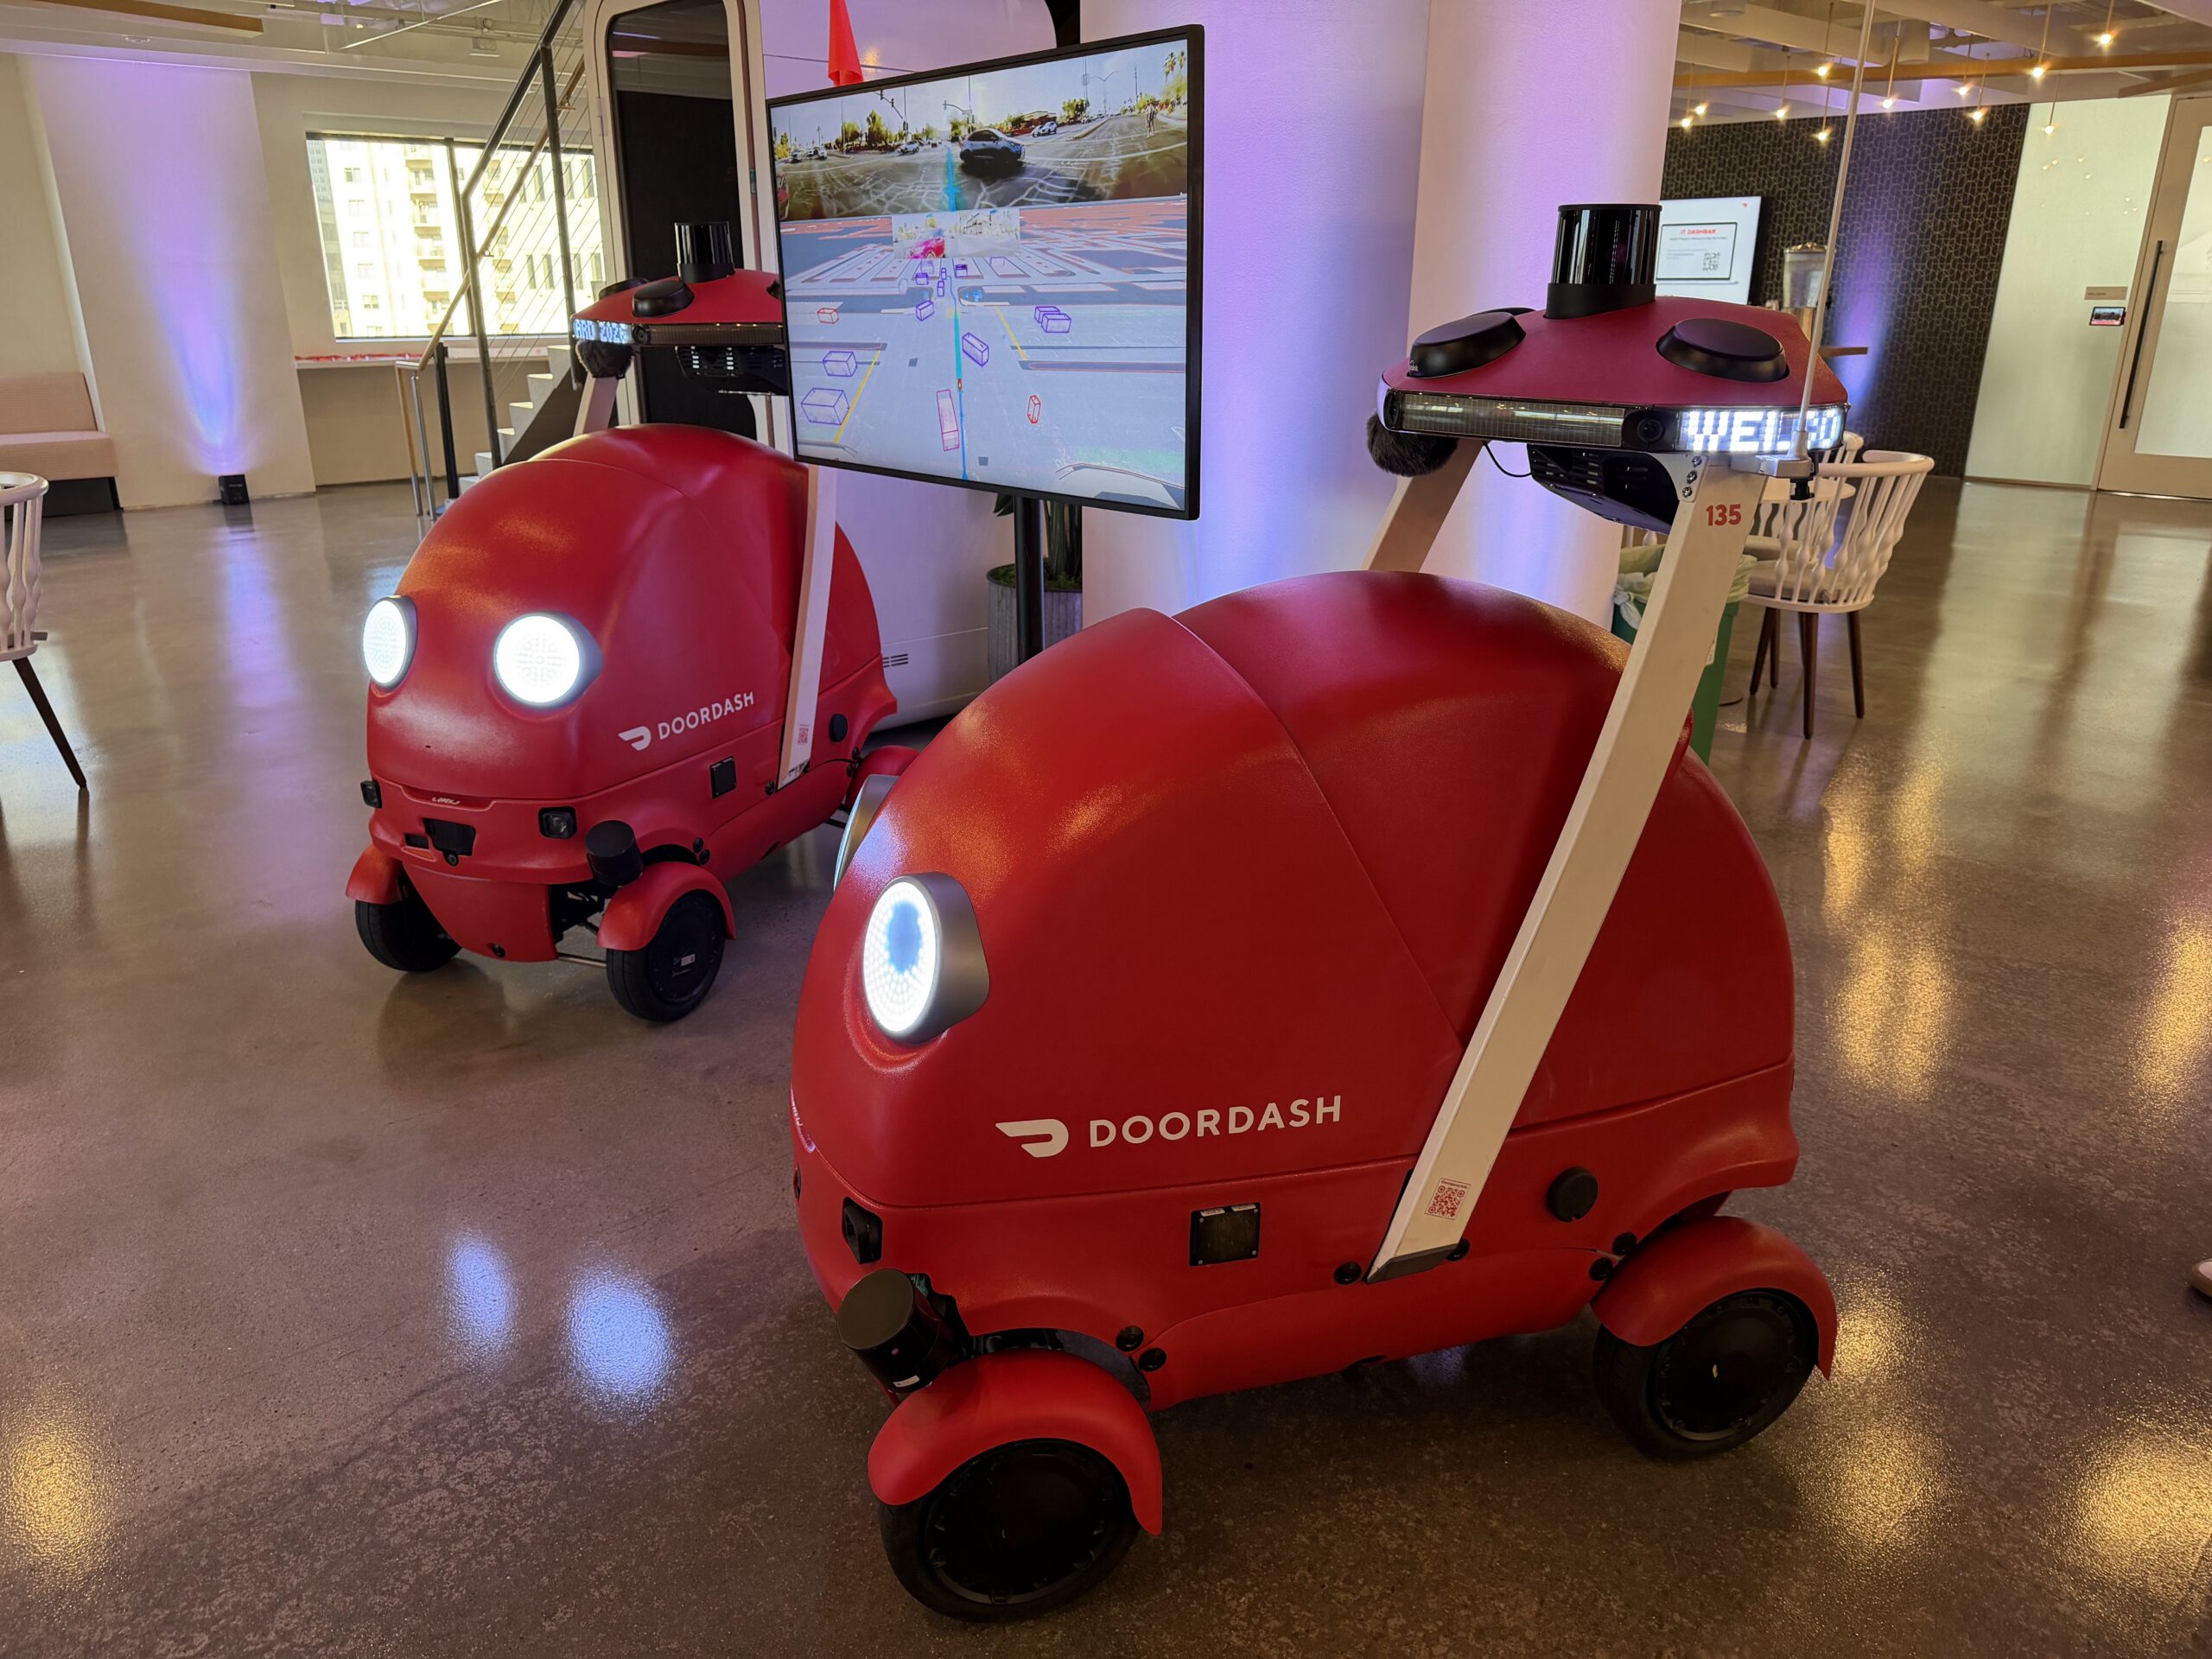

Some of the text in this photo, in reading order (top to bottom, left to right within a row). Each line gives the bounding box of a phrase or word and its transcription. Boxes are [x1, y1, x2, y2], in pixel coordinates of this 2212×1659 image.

[1706, 504, 1742, 526] 135
[658, 691, 754, 740] DOORDASH
[1090, 1095, 1341, 1147] DOORDASH
